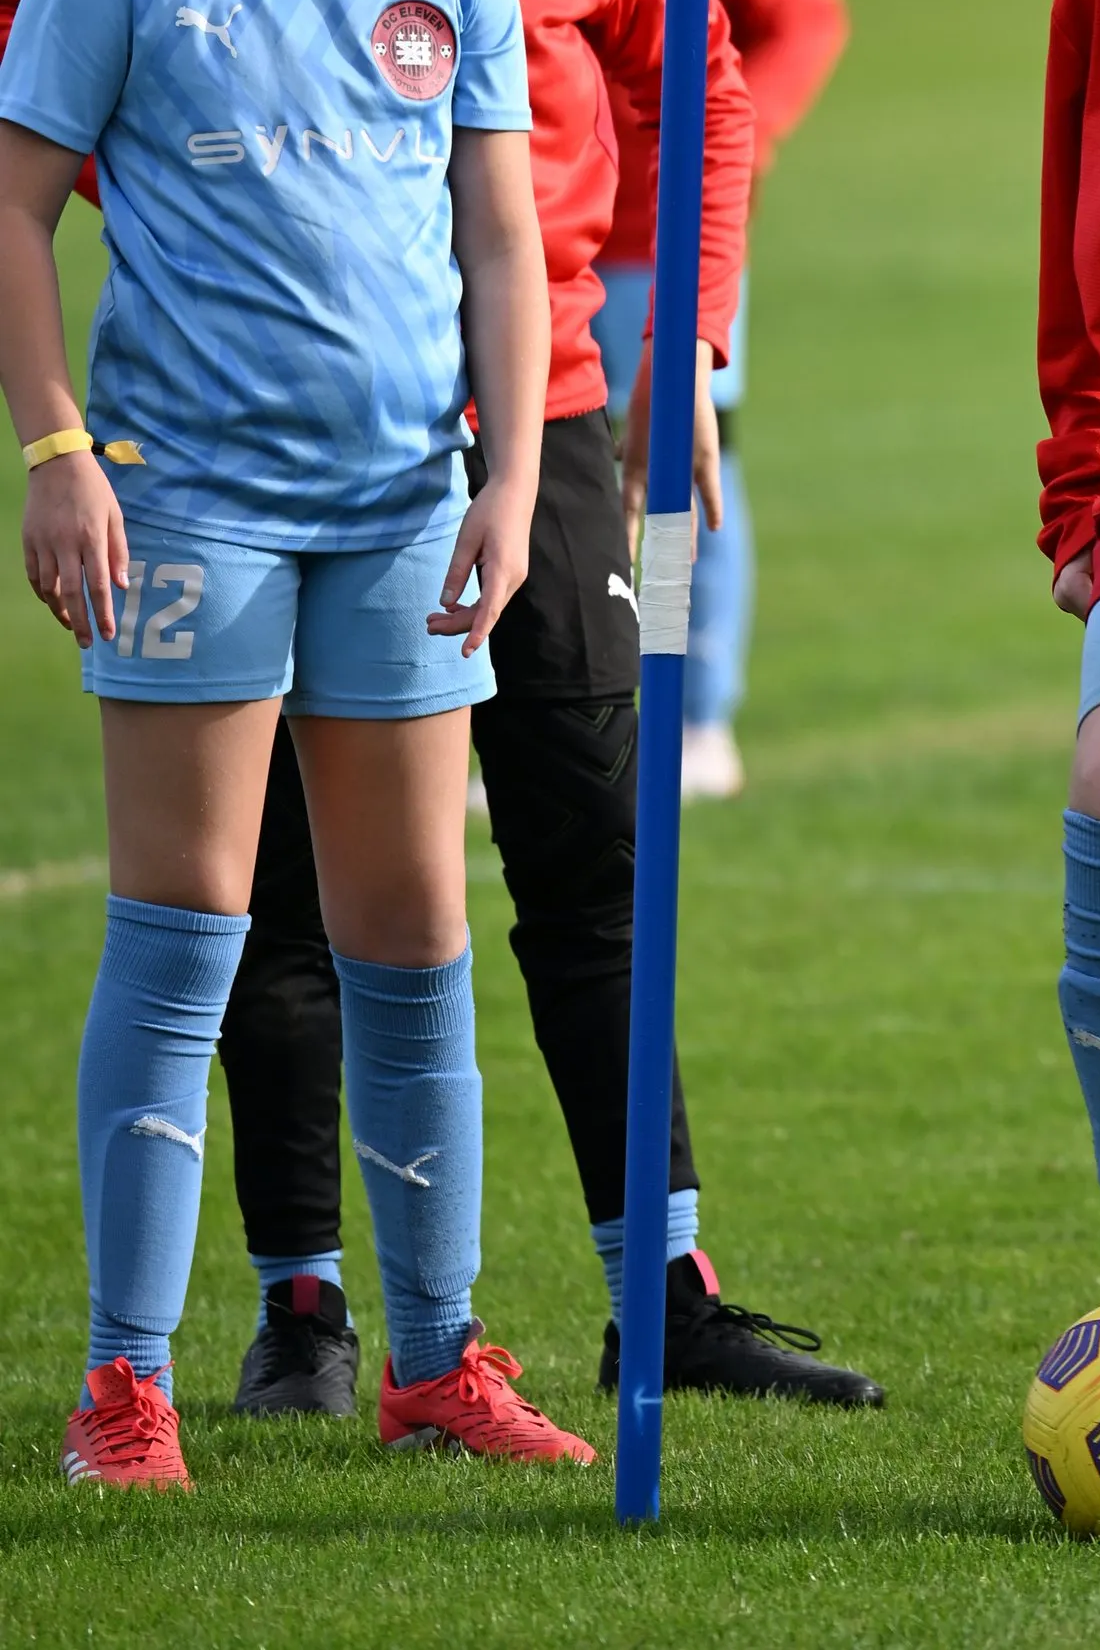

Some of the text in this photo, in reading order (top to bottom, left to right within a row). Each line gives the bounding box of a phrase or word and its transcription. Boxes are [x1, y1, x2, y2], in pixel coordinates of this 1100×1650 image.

[381, 6, 444, 31] DC ELEVEN
[117, 560, 204, 659] 12
